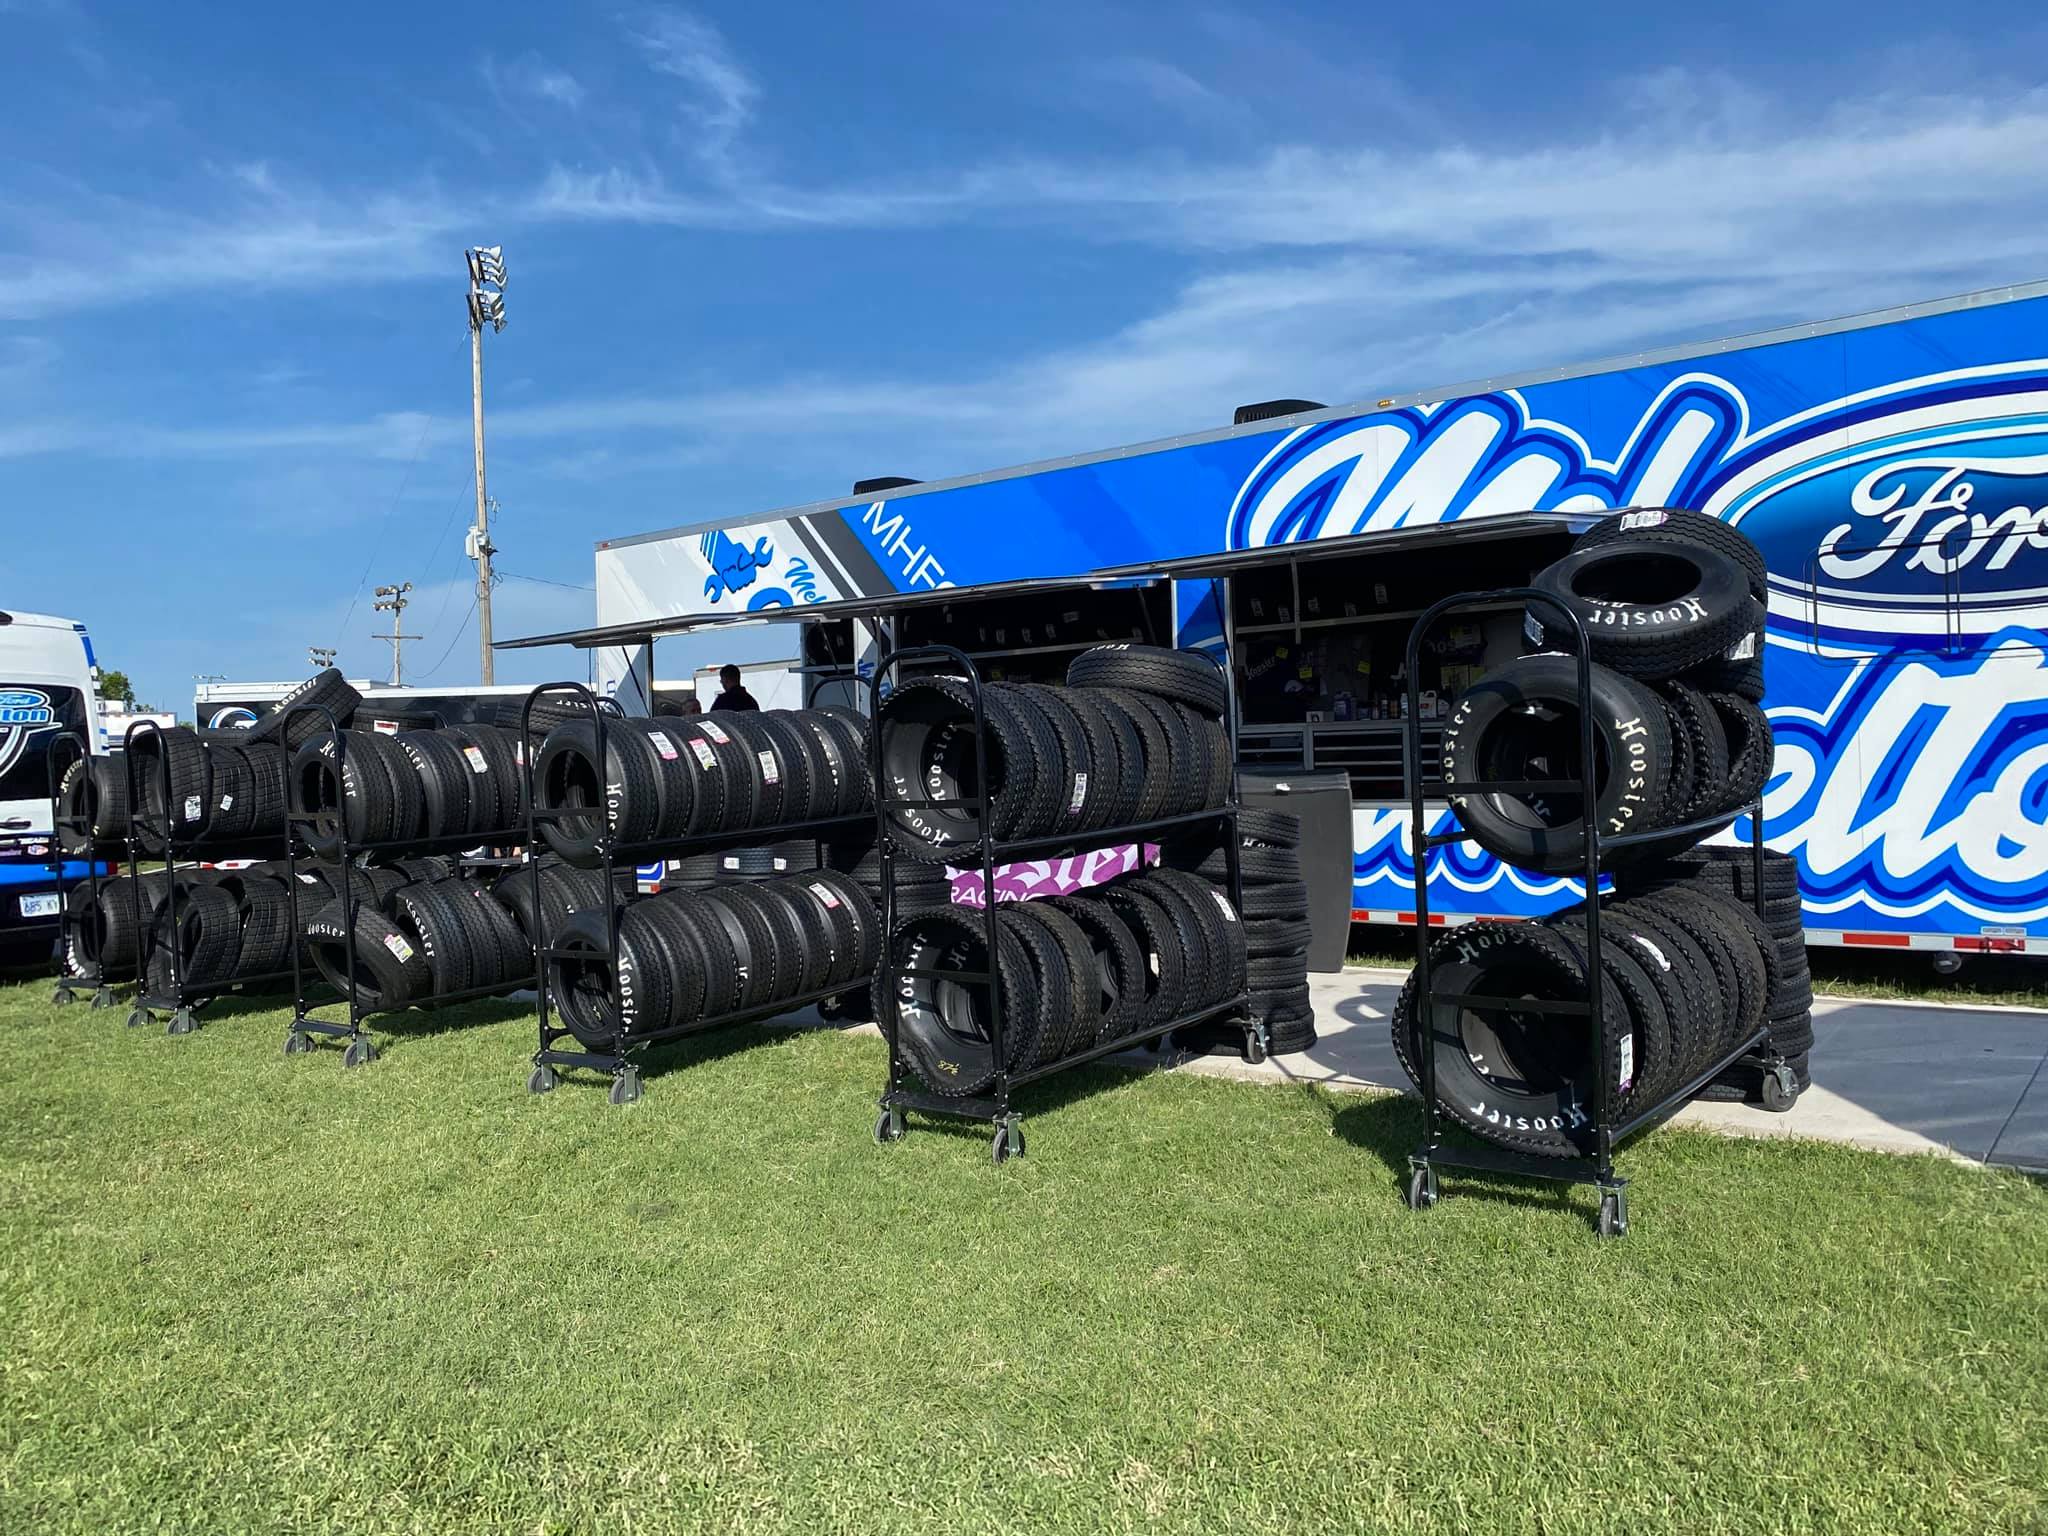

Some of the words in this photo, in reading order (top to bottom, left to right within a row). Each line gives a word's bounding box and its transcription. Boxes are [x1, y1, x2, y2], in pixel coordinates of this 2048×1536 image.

[861, 500, 957, 589] MHF
[1818, 456, 2048, 580] For
[1587, 597, 1709, 632] Hoosier
[271, 677, 317, 715] Hoosier
[1609, 717, 1648, 832] Hoosier
[893, 776, 951, 848] Hooser
[1469, 1101, 1588, 1131] Hoosier
